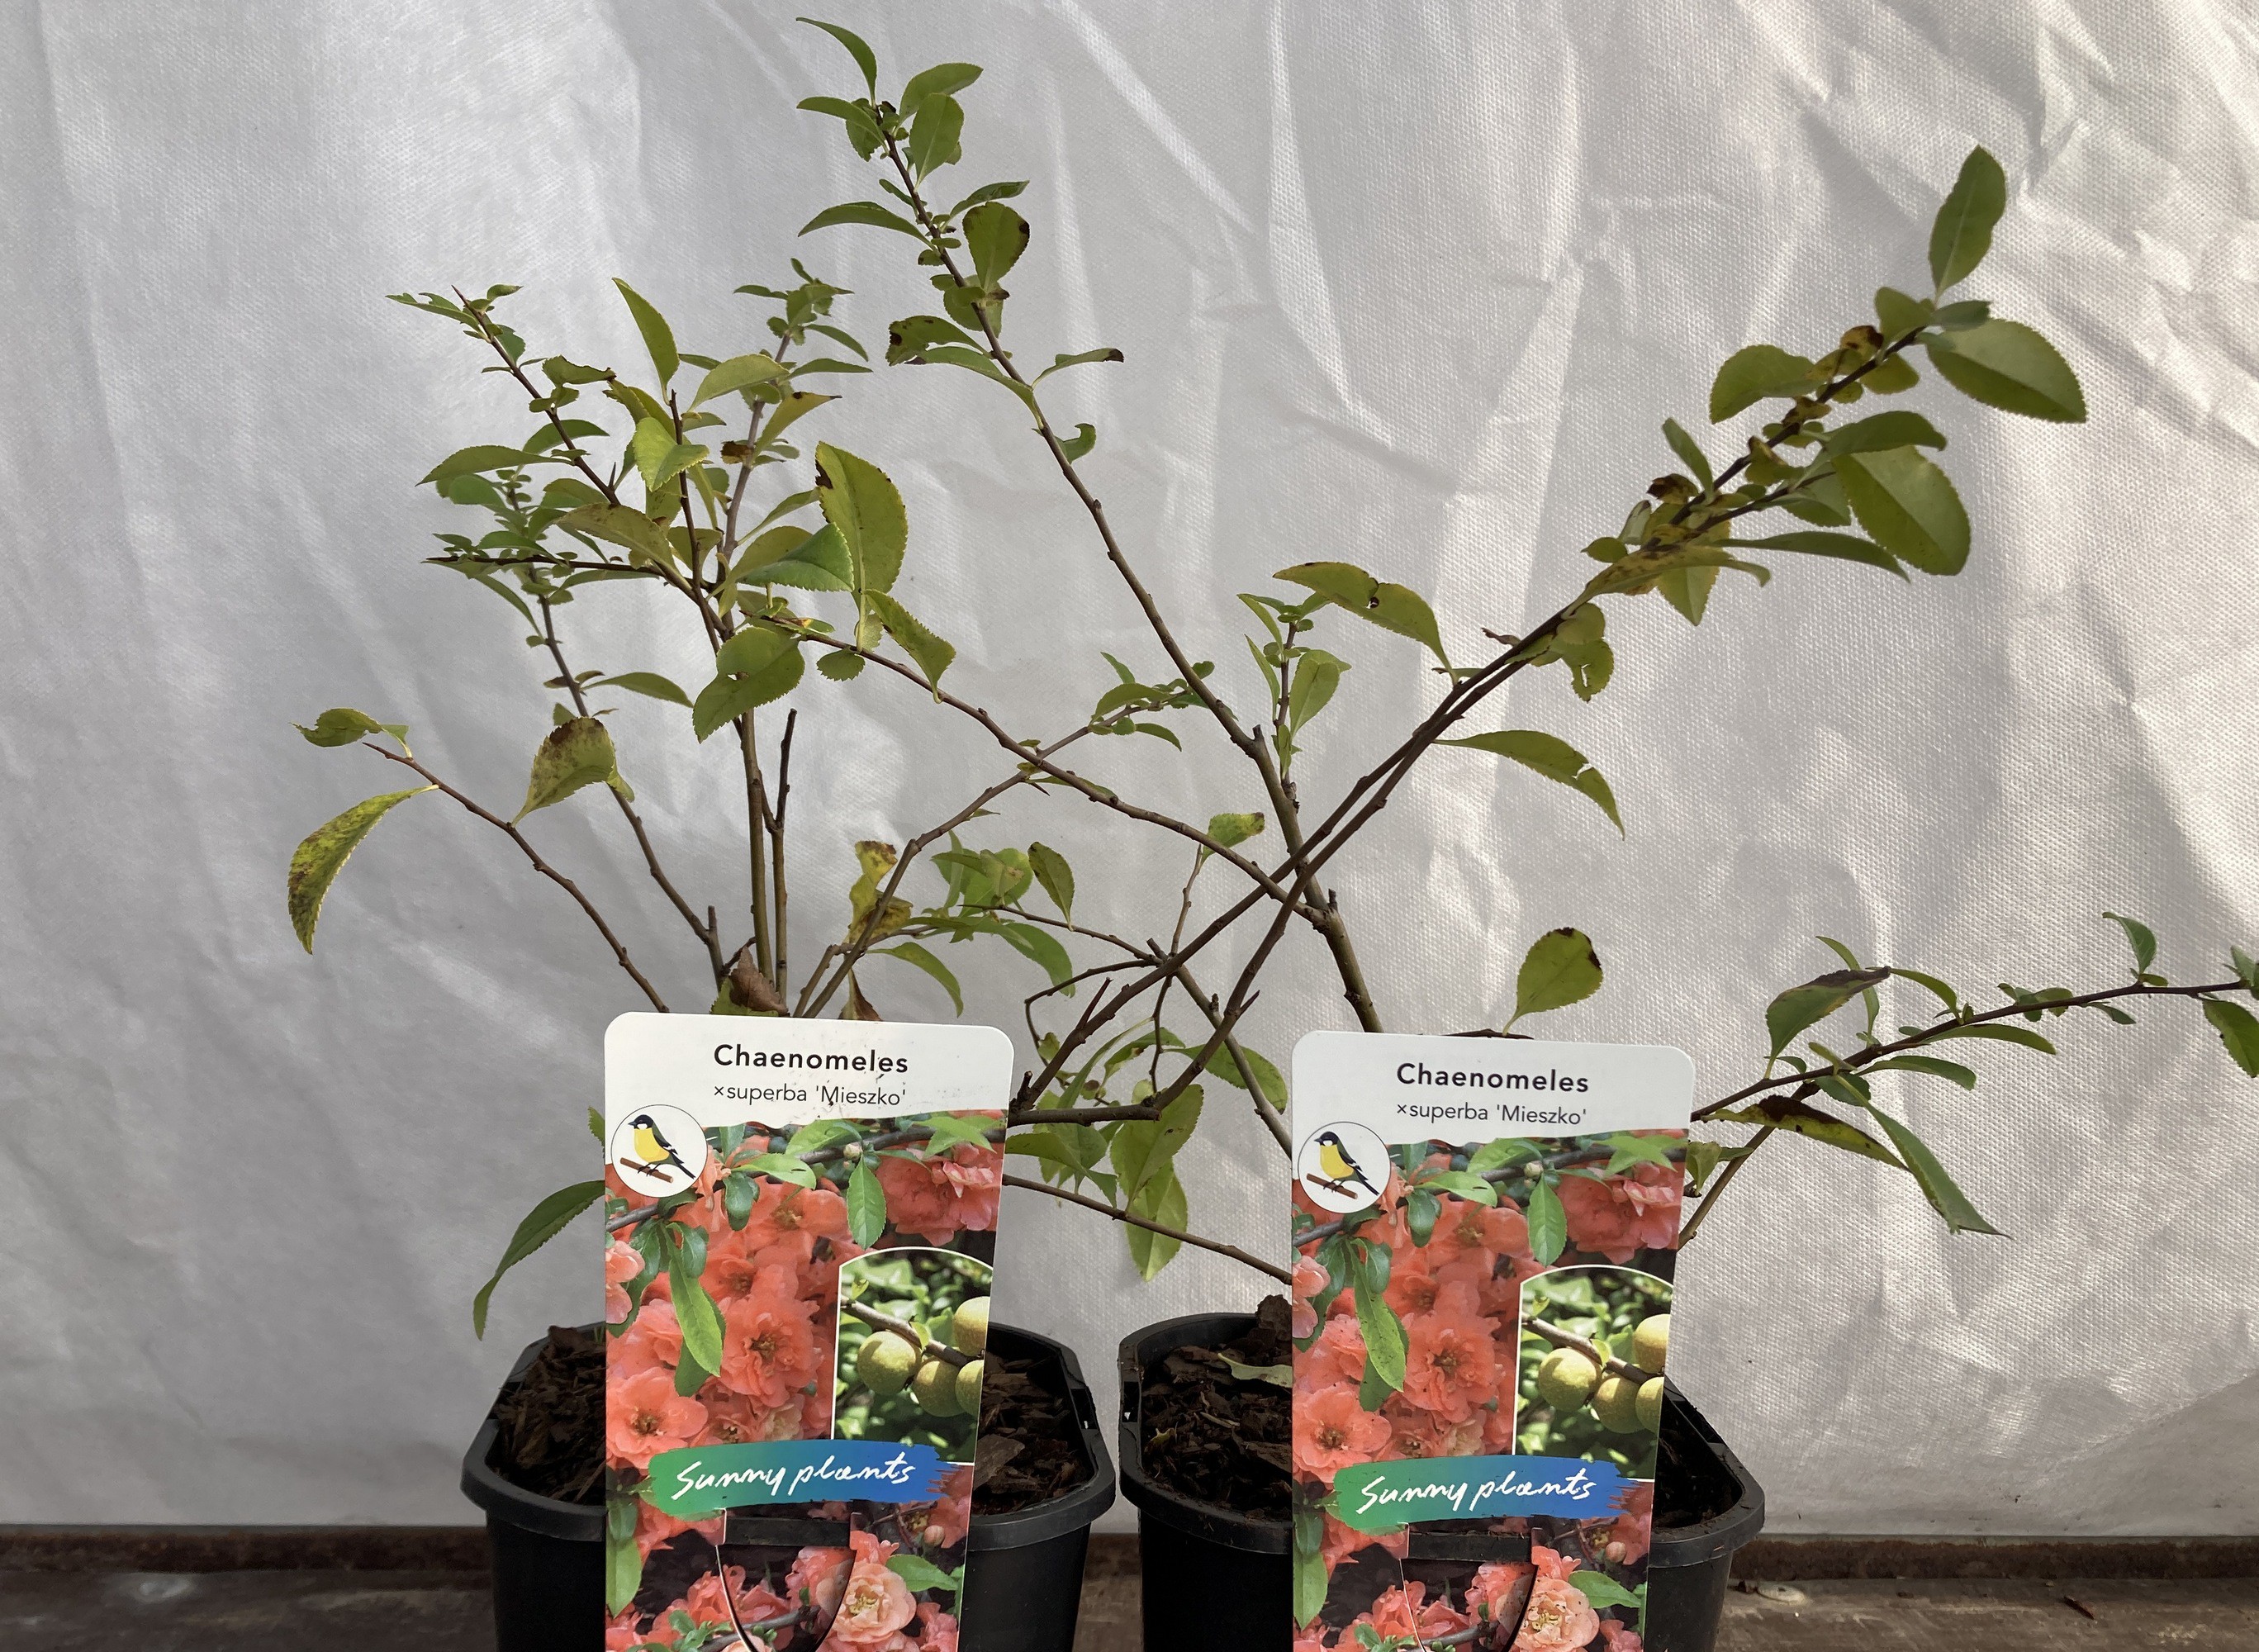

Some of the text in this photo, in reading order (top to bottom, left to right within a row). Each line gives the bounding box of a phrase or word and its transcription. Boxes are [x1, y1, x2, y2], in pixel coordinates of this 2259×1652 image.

[714, 1043, 909, 1074] Chaenomeles
[1396, 1062, 1590, 1093] Chaenomeles
[671, 1451, 917, 1502] Sunny plants
[1355, 1467, 1597, 1515] Sunny plants
